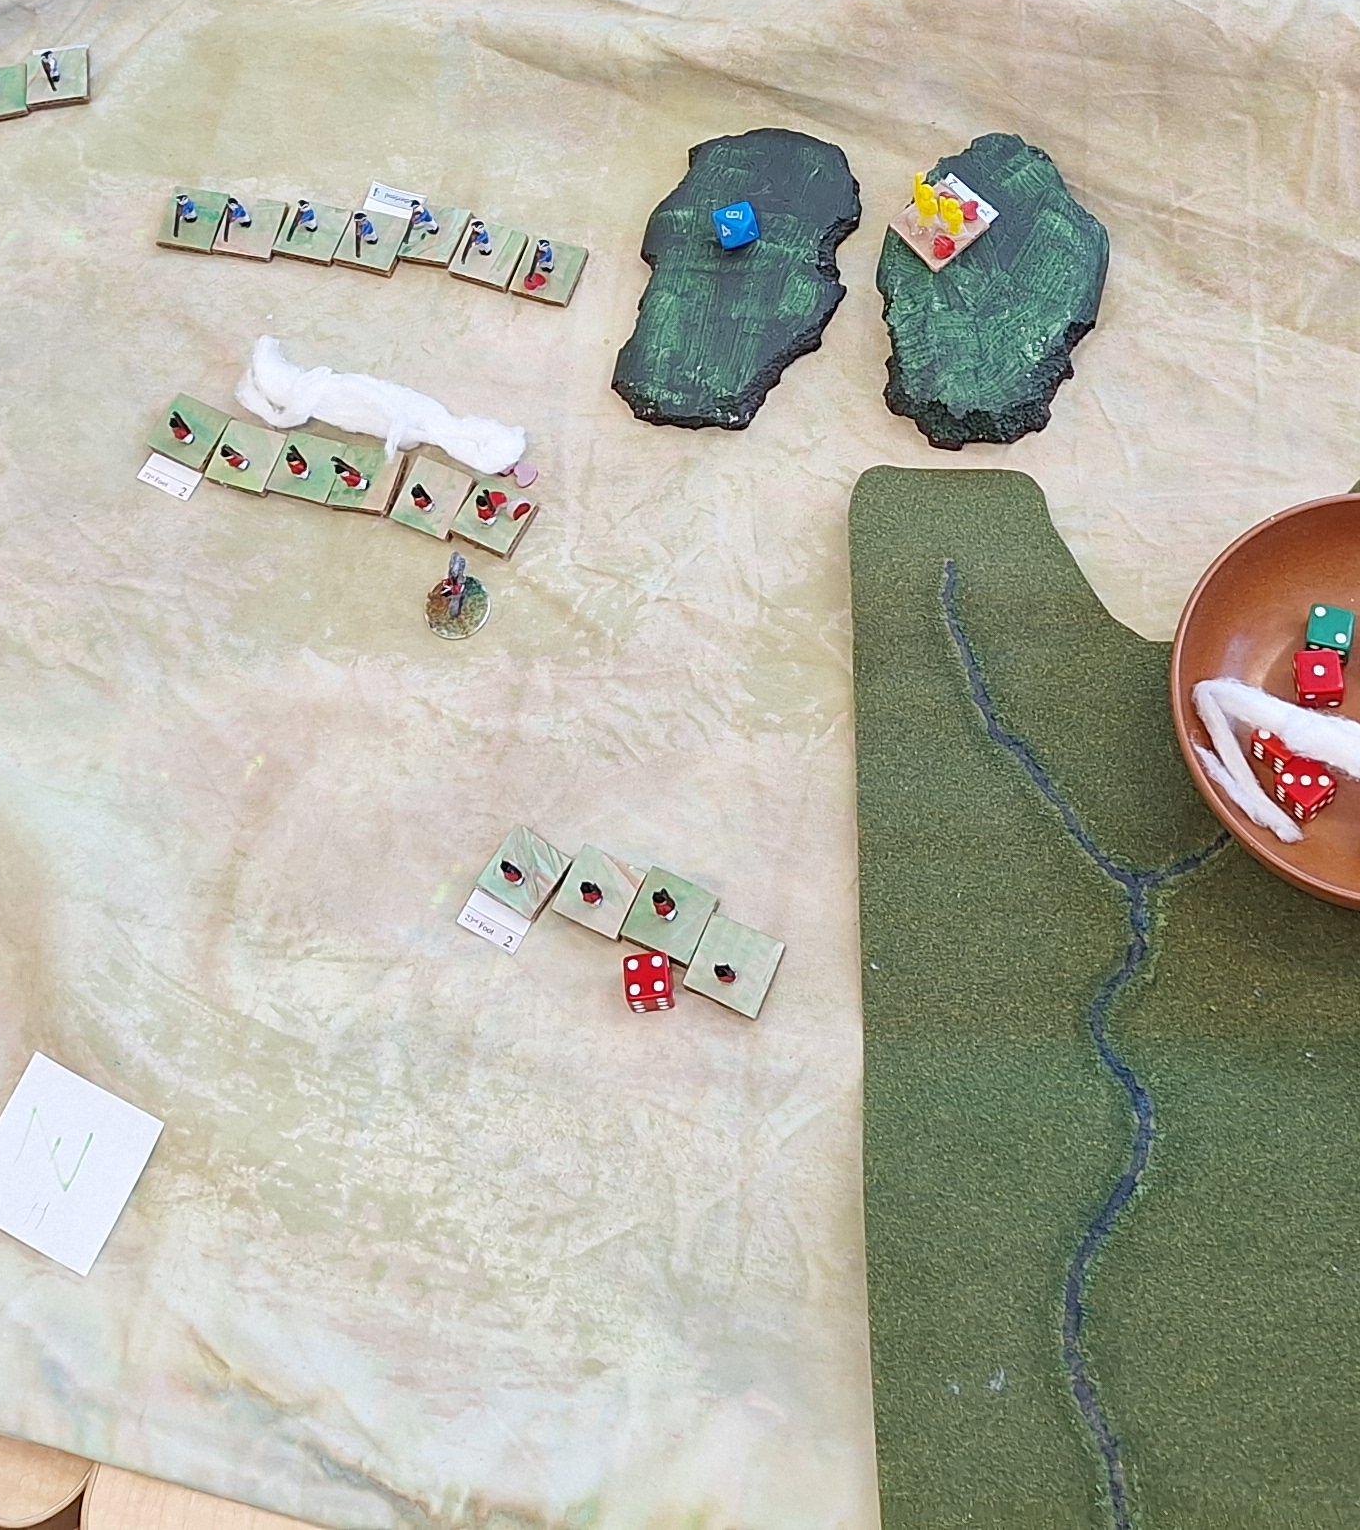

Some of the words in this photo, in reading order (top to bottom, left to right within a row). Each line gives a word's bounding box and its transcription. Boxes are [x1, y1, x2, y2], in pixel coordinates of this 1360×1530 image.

[178, 486, 188, 497] 2
[479, 920, 494, 936] Foot
[502, 935, 514, 948] 2
